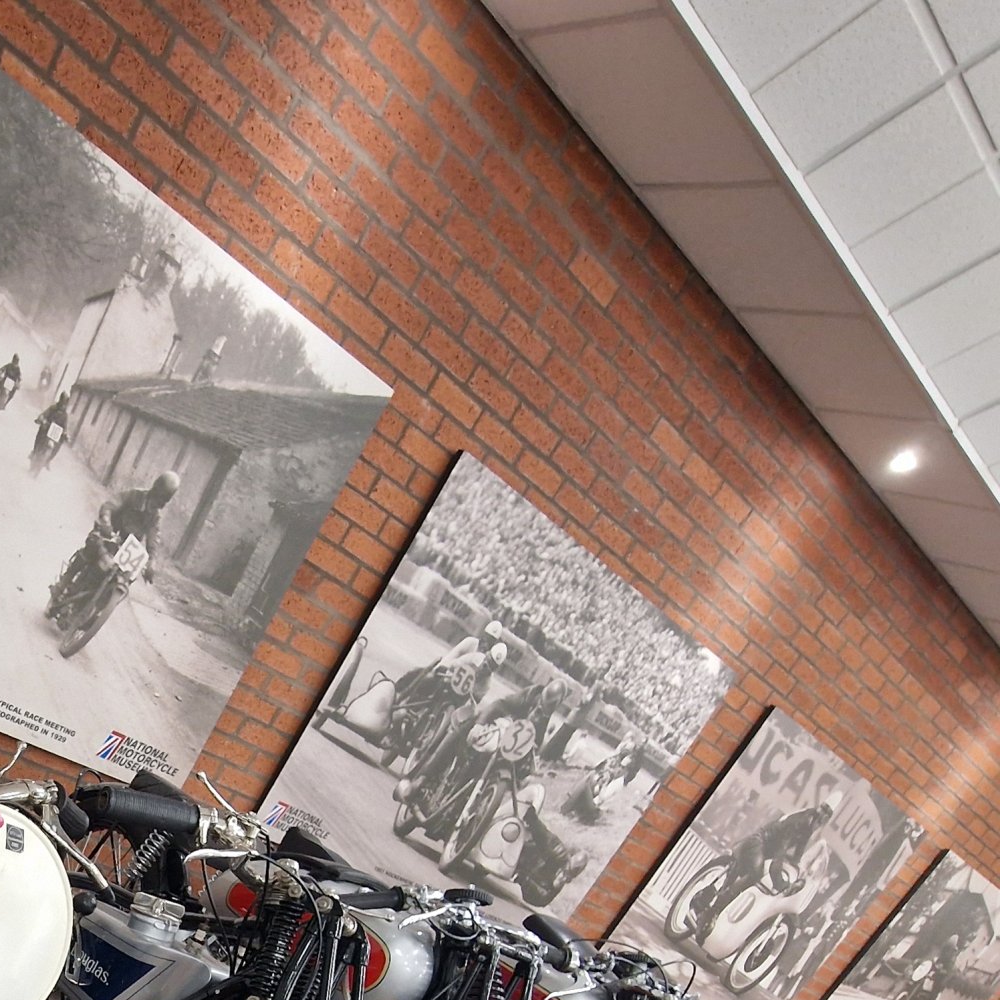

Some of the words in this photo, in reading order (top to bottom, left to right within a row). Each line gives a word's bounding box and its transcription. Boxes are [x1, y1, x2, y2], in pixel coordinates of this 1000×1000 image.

[119, 539, 145, 574] 54
[453, 667, 474, 694] 56
[23, 711, 45, 724] RACE
[44, 719, 76, 737] MEETING
[40, 728, 49, 736] IN
[50, 732, 67, 743] 1929
[123, 737, 169, 762] NATIONAL
[502, 721, 534, 755] 32
[111, 754, 153, 773] MUSEU
[117, 746, 179, 776] MOTORCYCLE
[287, 806, 324, 827] NATIONAL
